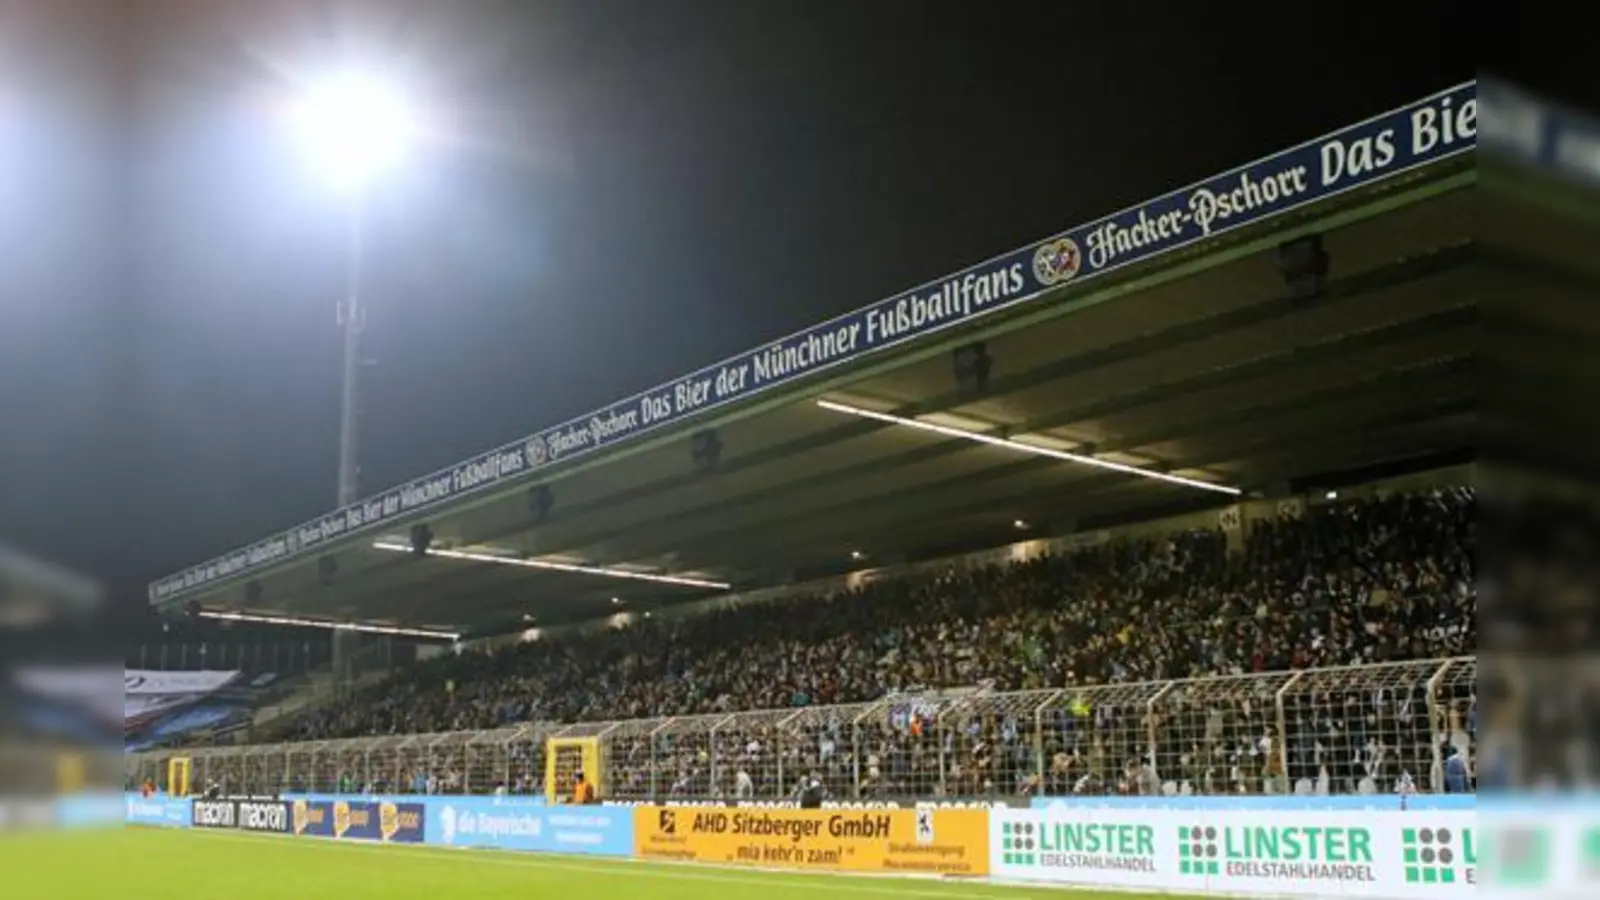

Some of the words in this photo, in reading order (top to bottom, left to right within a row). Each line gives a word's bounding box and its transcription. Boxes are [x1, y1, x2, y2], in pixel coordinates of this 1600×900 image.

[1086, 161, 1307, 269] Hacker-Pschorr
[1320, 128, 1395, 187] Das
[640, 392, 672, 425] Das
[674, 379, 711, 412] Bier
[716, 359, 749, 397] der
[752, 320, 861, 385] Münchner
[865, 260, 1025, 344] Fußballfans
[194, 801, 235, 827] macron
[239, 802, 287, 831] macron
[692, 812, 728, 834] AHD
[732, 811, 822, 842] Sitzberger
[828, 813, 892, 839] GmbH
[1039, 822, 1156, 855] LINSTER
[1224, 825, 1373, 863] LINSTER
[1039, 853, 1157, 873] EDELSTAHLHANDEL
[1225, 861, 1377, 882] EDELSTAHLHANDEL
